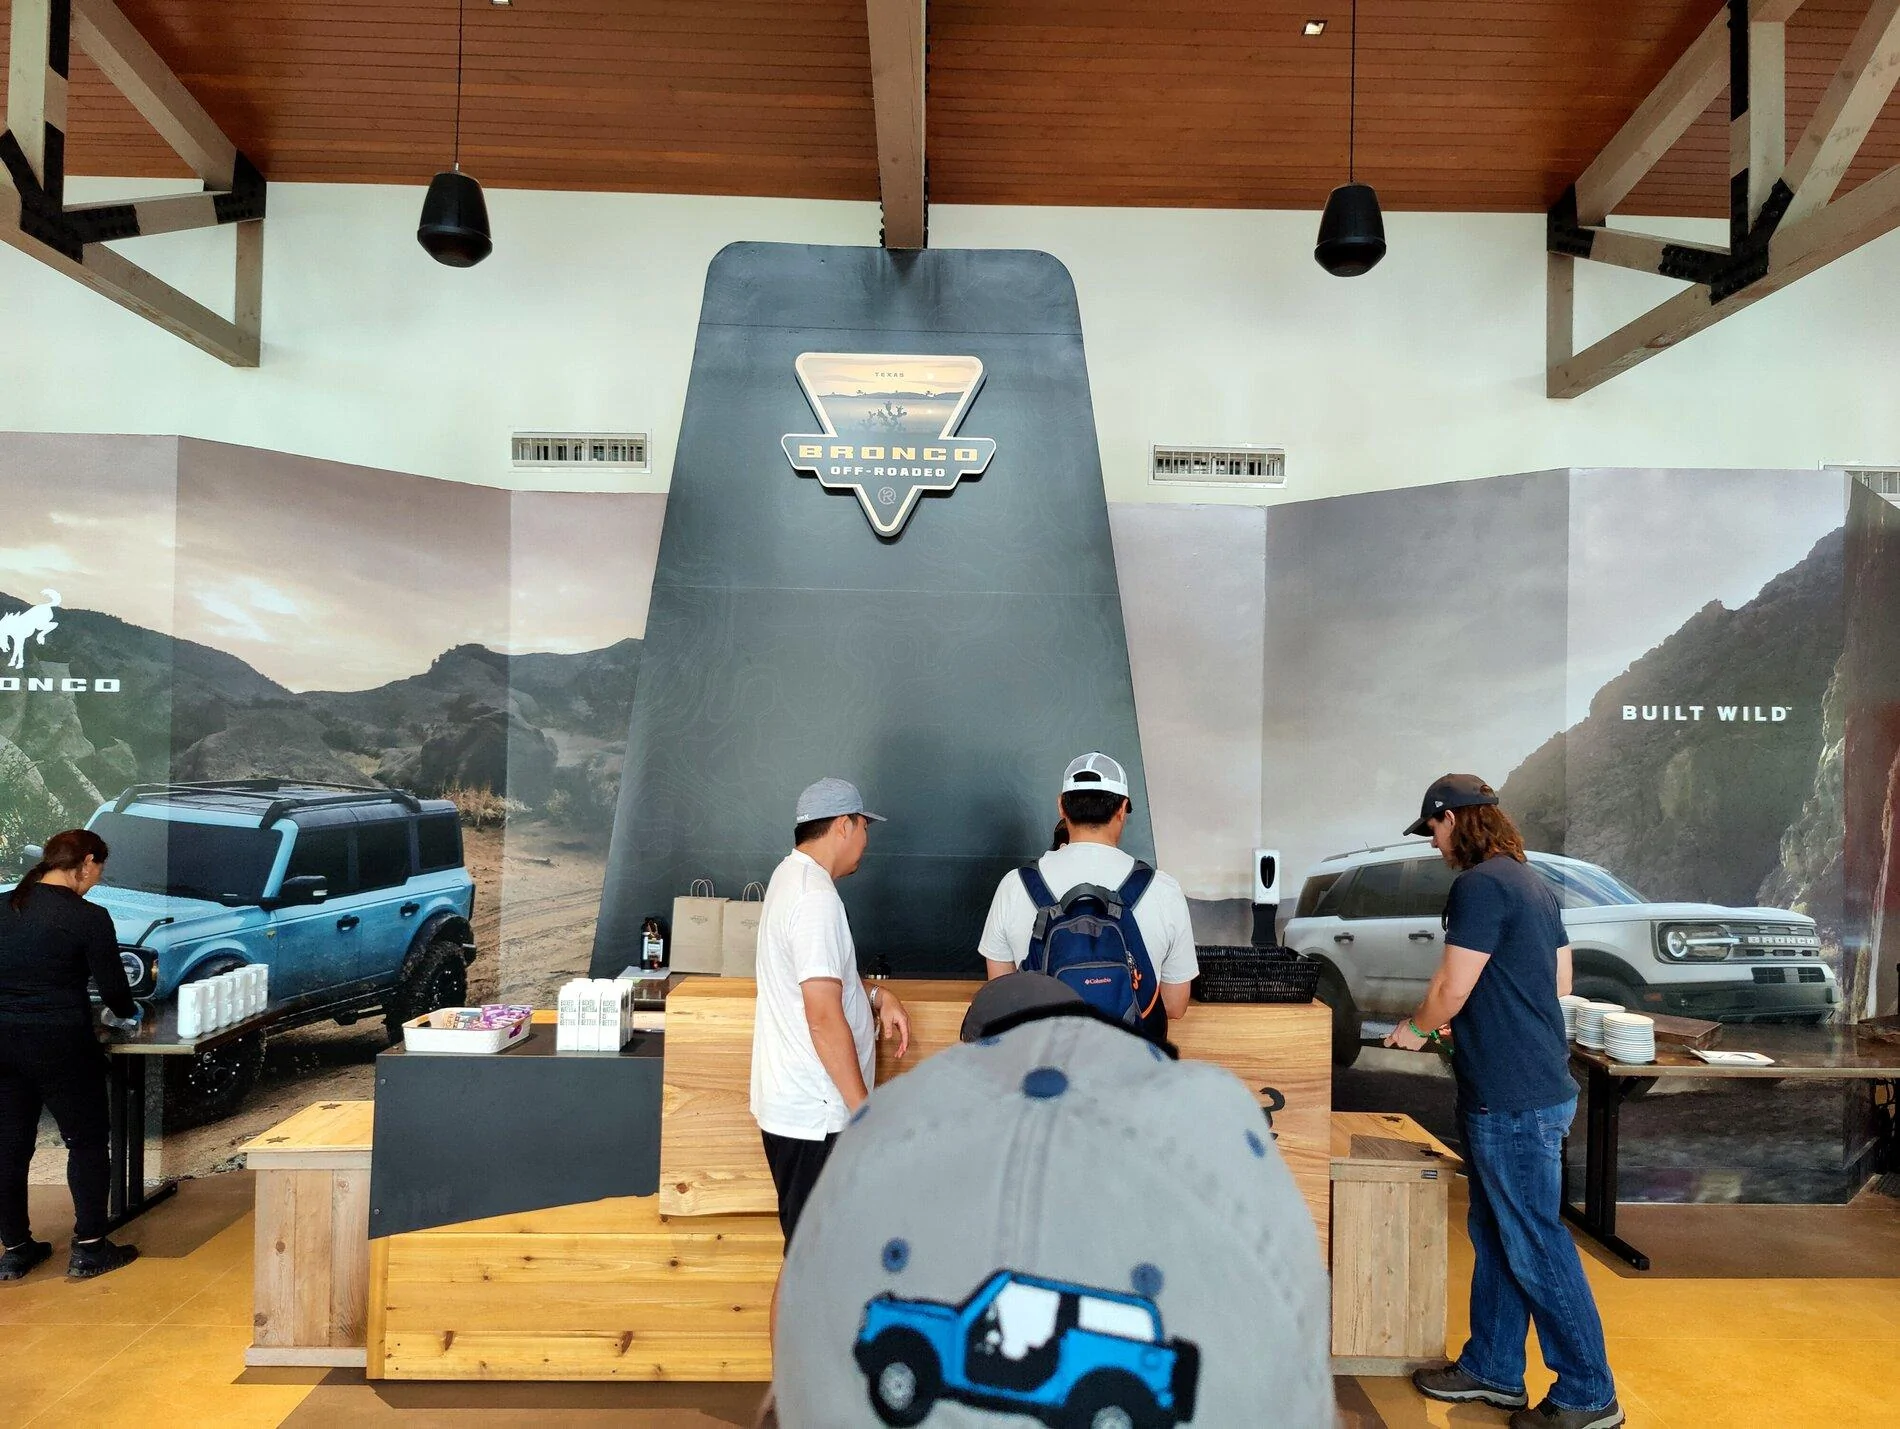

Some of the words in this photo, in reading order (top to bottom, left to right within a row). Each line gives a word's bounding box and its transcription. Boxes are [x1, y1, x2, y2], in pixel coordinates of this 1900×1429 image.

[799, 445, 977, 461] BRONCO
[830, 466, 947, 478] OFF-ROADEO
[1622, 705, 1705, 721] BUILT
[1747, 936, 1816, 945] BRONCO
